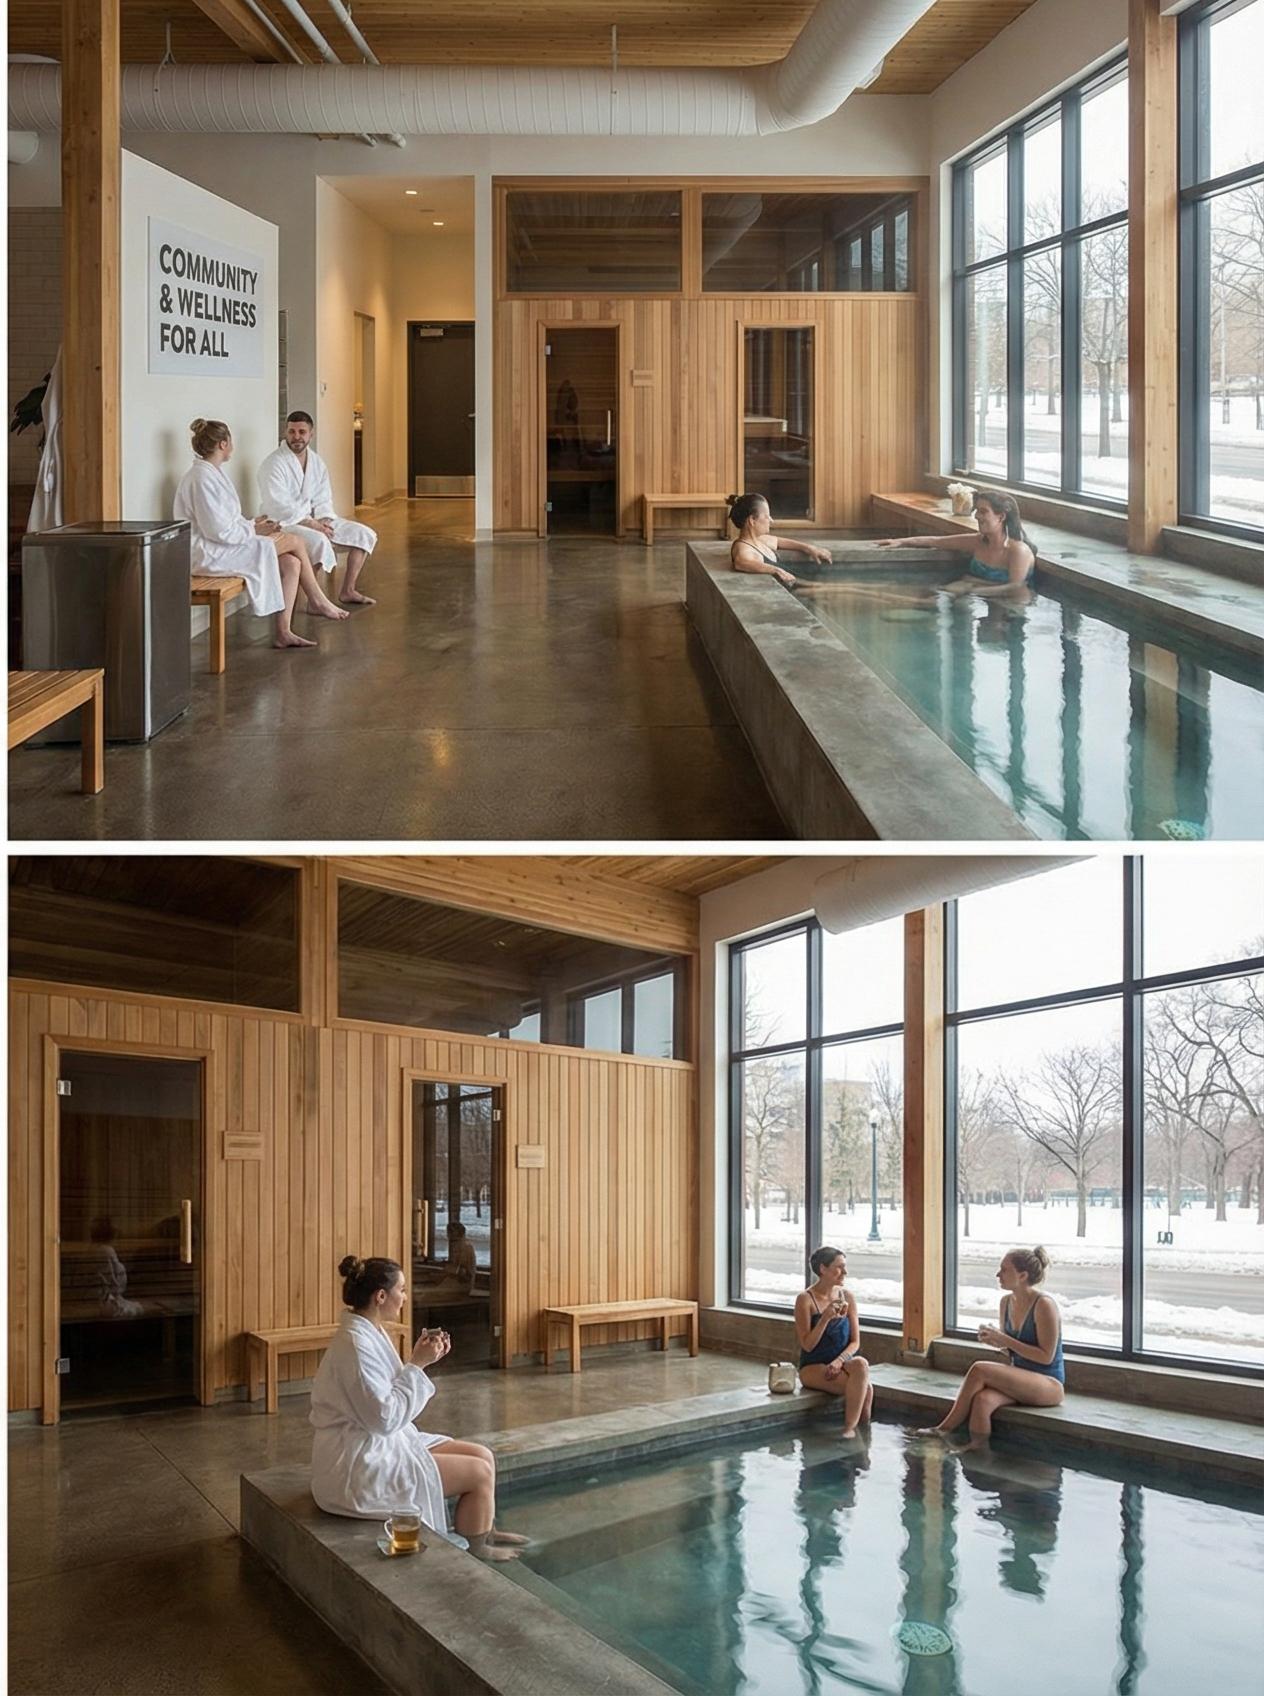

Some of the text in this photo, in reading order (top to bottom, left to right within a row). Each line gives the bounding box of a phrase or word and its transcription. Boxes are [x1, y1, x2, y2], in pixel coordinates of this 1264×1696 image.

[159, 244, 258, 295] COMMUNITY
[159, 283, 257, 328] & WELLNESS
[160, 322, 229, 357] FOR ALL
